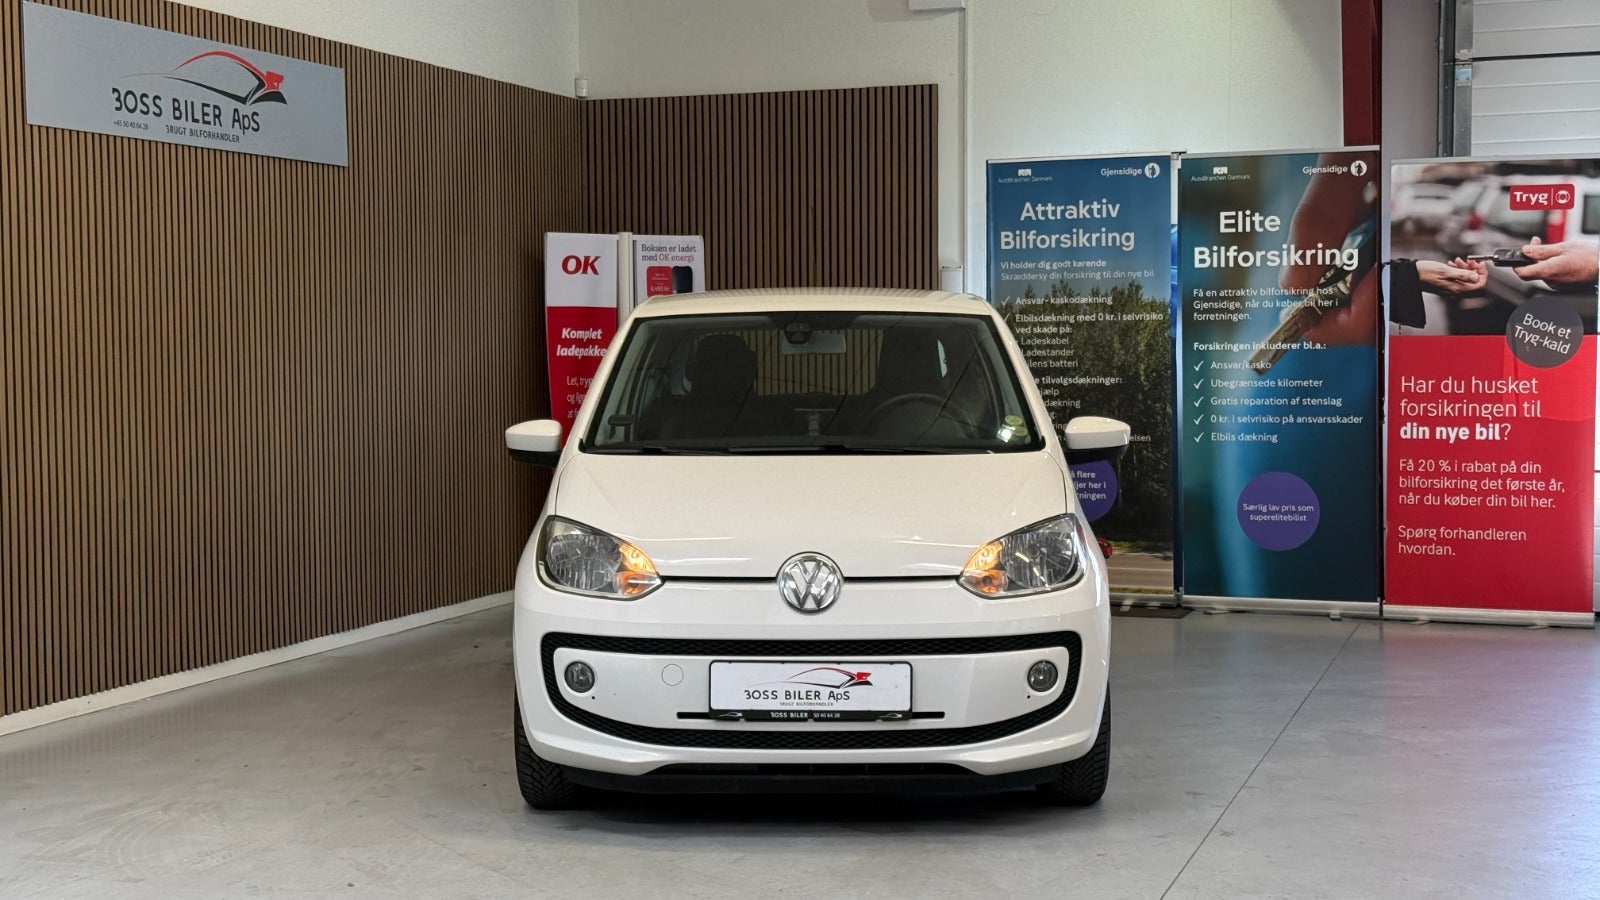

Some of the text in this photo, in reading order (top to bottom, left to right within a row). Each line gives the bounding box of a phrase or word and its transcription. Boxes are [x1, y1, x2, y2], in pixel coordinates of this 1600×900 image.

[172, 98, 222, 127] BILER
[232, 108, 260, 135] ApS
[190, 129, 239, 143] BILFORHANDLER
[1101, 168, 1142, 176] Gjensidige
[1303, 166, 1348, 175] Gjensidige
[1514, 191, 1548, 205] Tryg
[1020, 199, 1120, 221] Attraktiv
[1220, 210, 1280, 233] Elite
[1001, 228, 1134, 251] Bilforsikring
[642, 244, 667, 252] Boksen
[671, 255, 694, 263] energi
[1194, 243, 1358, 271] Bilforsikring
[562, 255, 601, 275] OK
[1038, 261, 1050, 269] dig
[1052, 261, 1071, 269] godt
[1001, 272, 1047, 281] Skræddersy
[1064, 271, 1101, 280] forsikring
[1113, 270, 1126, 278] din
[1128, 271, 1142, 279] nye
[1144, 269, 1154, 277] bil
[1194, 288, 1203, 297] Få
[1219, 288, 1257, 297] attraktiv
[1260, 287, 1313, 297] bilforsikring
[1051, 296, 1112, 305] kaskodækning
[1194, 299, 1338, 310] Gjensidige, når du køber bil her i
[1016, 315, 1075, 323] Elbilsdækning
[1098, 313, 1103, 321] 0
[1106, 313, 1116, 321] kr.
[1123, 312, 1163, 320] selvrisiko
[1194, 312, 1252, 321] forretningen.
[1060, 326, 1072, 334] på:
[1523, 314, 1572, 339] Book et
[562, 328, 603, 340] Komplet
[1514, 326, 1570, 354] Tryg-kald
[1194, 342, 1250, 352] Forsikringen
[1253, 341, 1300, 350] inkluderer
[1022, 349, 1074, 357] Ladestander
[1211, 360, 1272, 370] Ansvar/kasko
[1042, 376, 1122, 385] tilvalgsdækninger:
[1211, 379, 1323, 389] Ubegrænsede kilometer
[1401, 376, 1538, 394] Har du husket
[1040, 388, 1059, 397] jælp
[1044, 399, 1081, 408] dækning
[1211, 397, 1342, 407] Gratis reparation af stenslag
[1401, 400, 1541, 420] forsikringen til
[1211, 415, 1217, 423] 0
[1219, 415, 1230, 423] kr.
[1237, 415, 1279, 423] selvrisiko
[1282, 414, 1294, 425] på
[1297, 415, 1363, 424] ansvarsskader
[1211, 432, 1278, 443] Elbils dækning
[1400, 422, 1511, 444] din nye bil?
[1400, 459, 1541, 476] Få 20 % i rabat på din
[1400, 476, 1565, 493] bilforsikring det første år,
[1078, 492, 1106, 501] ningen
[1399, 492, 1556, 508] når du køber din bil her.
[1243, 503, 1268, 513] Særlig
[1282, 504, 1295, 513] pris
[1250, 514, 1307, 523] superelitebilist
[1398, 525, 1526, 540] Spørg forhandleren
[1399, 542, 1455, 556] hvordan.
[785, 690, 821, 700] BILER
[828, 691, 850, 702] ApS
